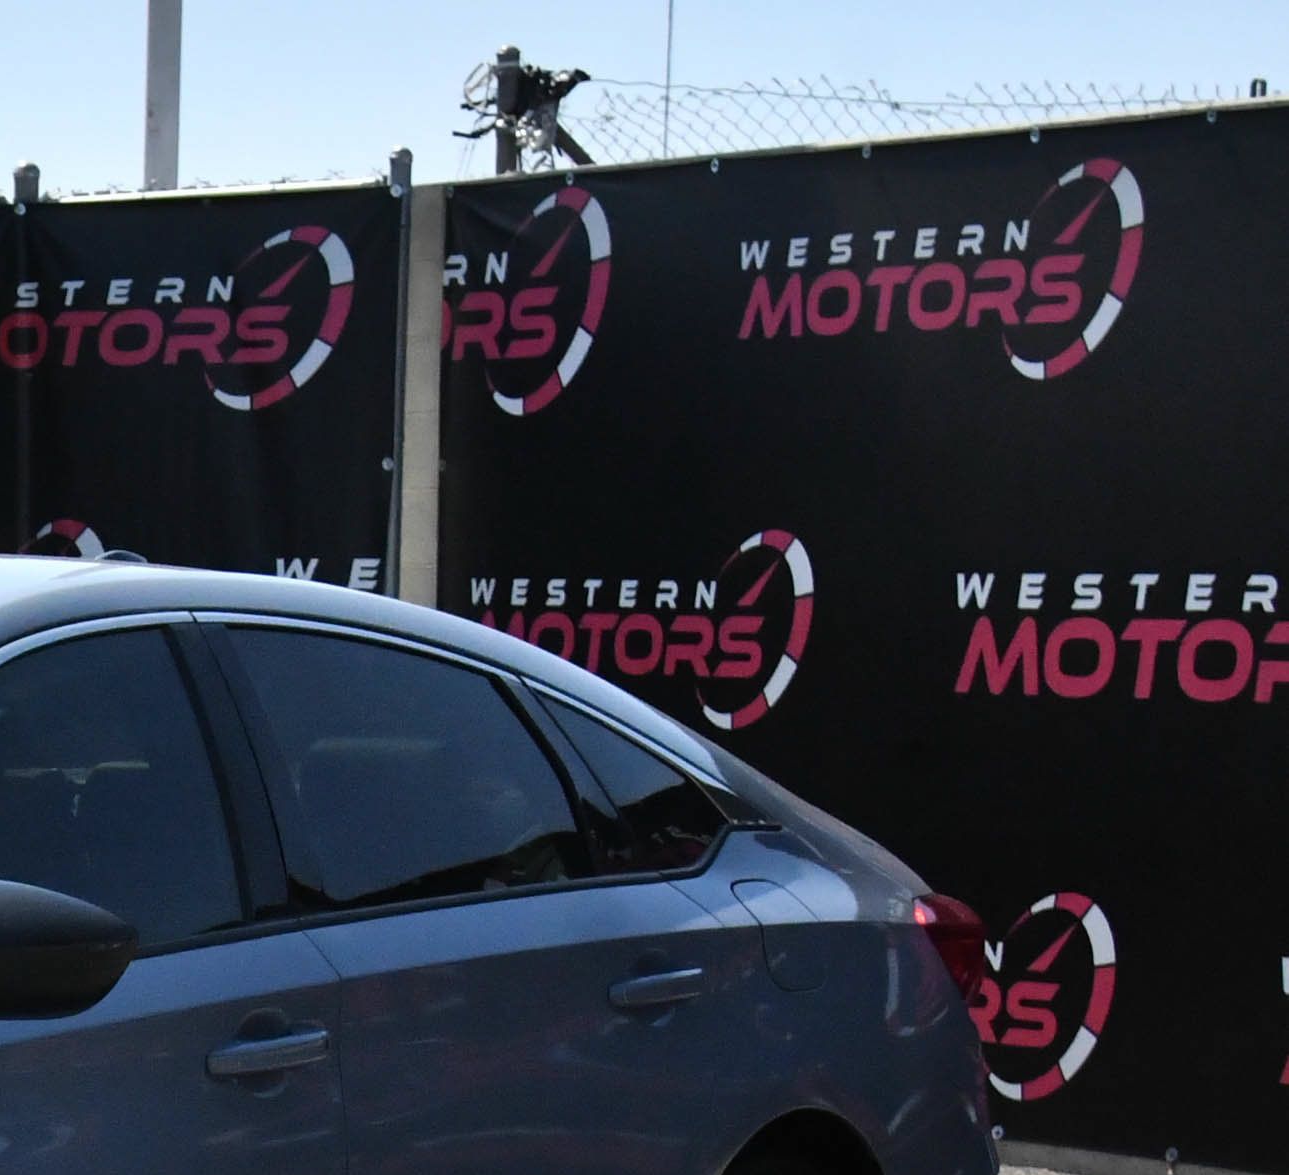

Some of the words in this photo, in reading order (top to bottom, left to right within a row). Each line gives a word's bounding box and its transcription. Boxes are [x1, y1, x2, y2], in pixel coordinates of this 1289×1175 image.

[740, 220, 1031, 270] WESTERN
[739, 253, 1086, 340] MOTORS
[440, 286, 558, 361] RS
[471, 577, 718, 609] WESTERN
[956, 572, 1279, 612] WESTER
